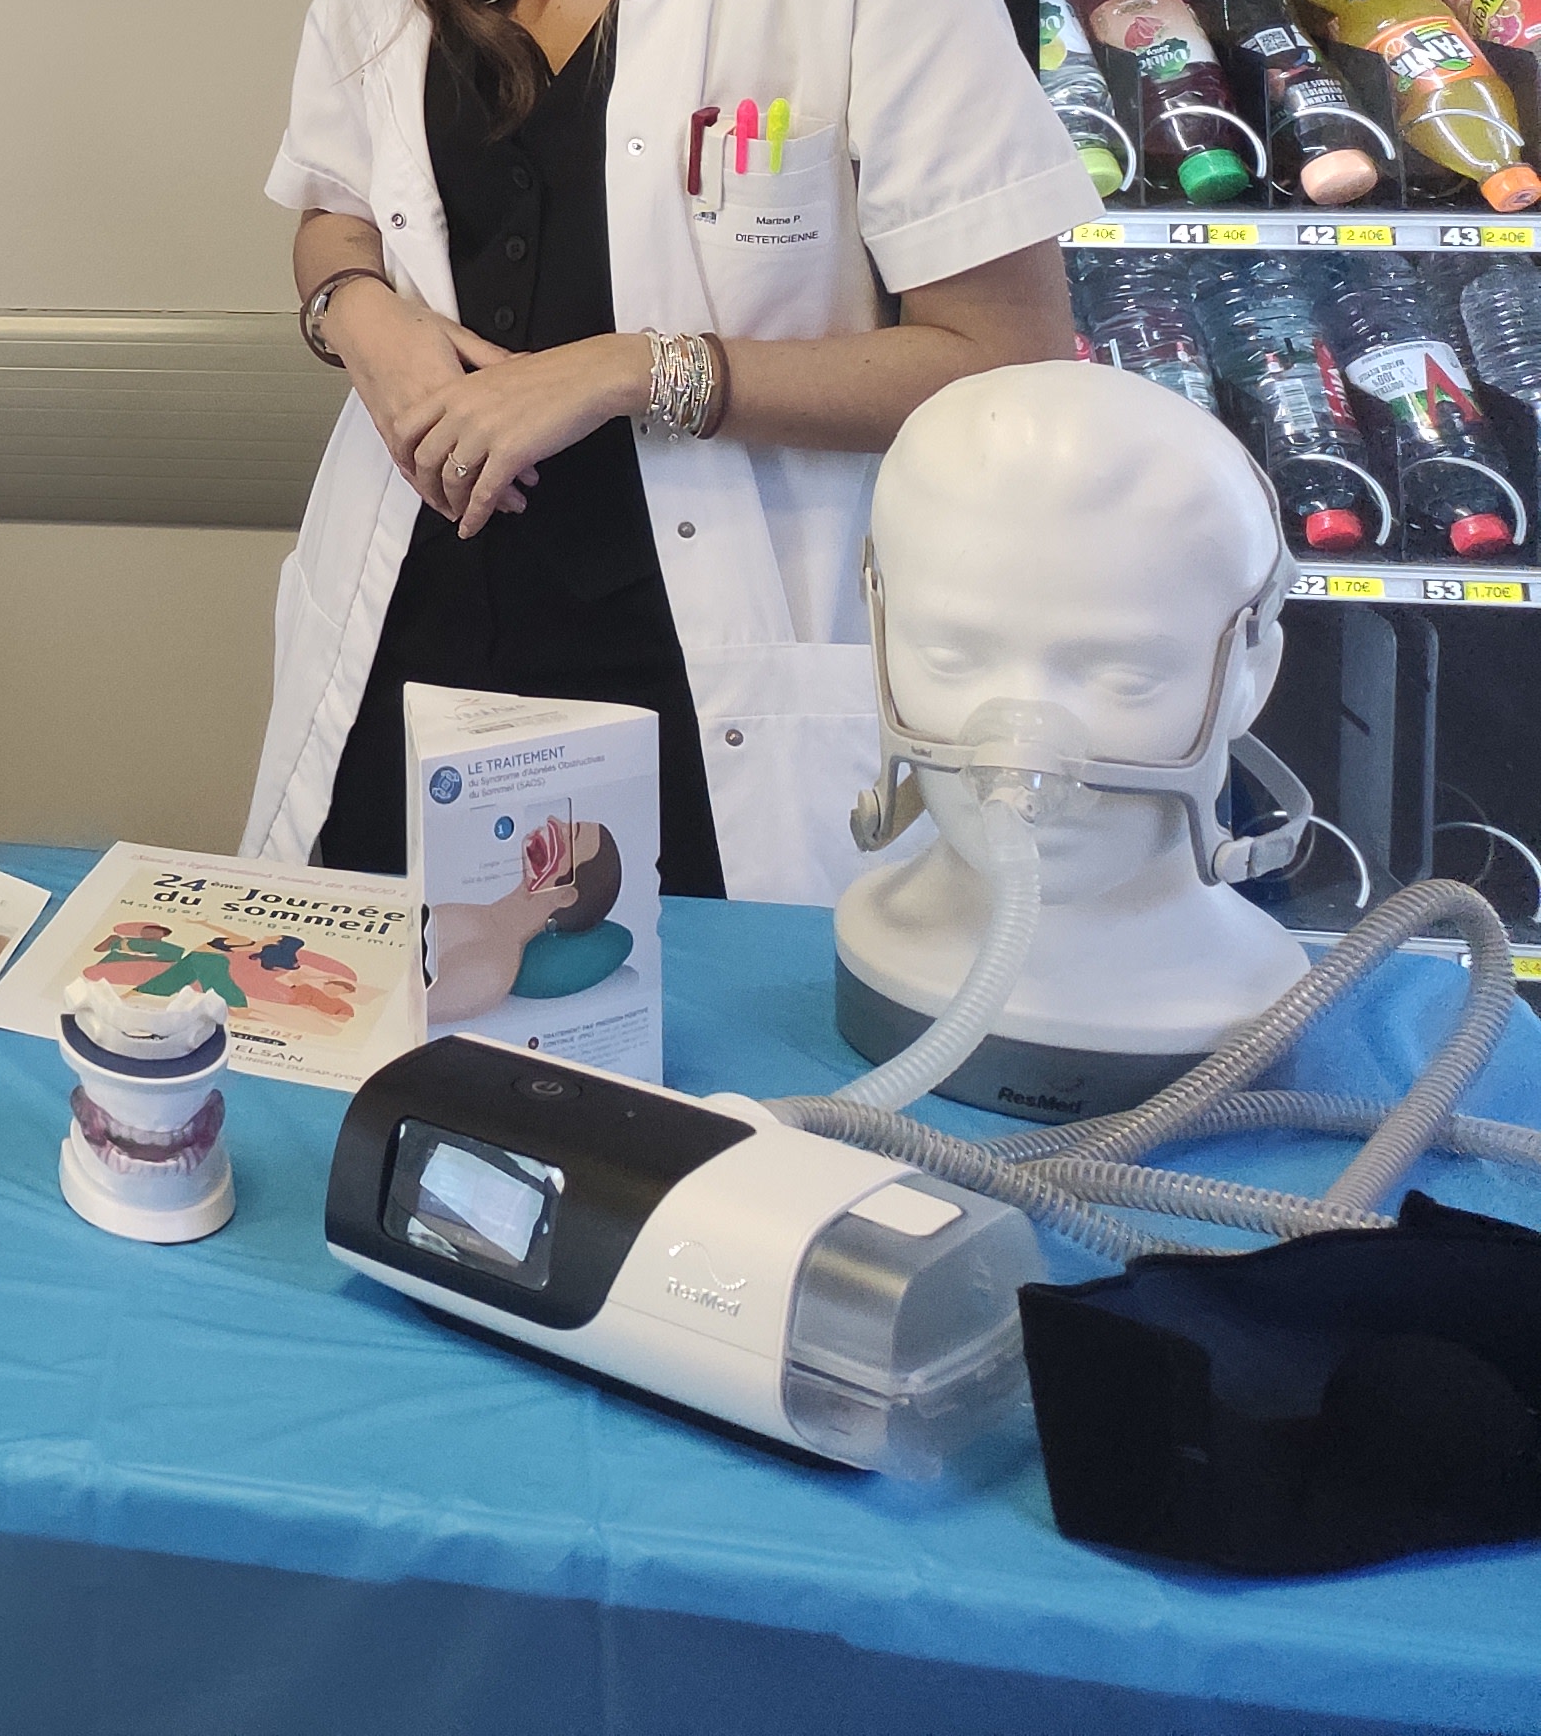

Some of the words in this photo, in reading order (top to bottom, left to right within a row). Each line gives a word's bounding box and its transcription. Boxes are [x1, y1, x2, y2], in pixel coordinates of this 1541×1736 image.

[736, 230, 819, 244] DIETETICIENNE
[1171, 224, 1204, 243] 41
[1299, 226, 1336, 244] 42
[1443, 227, 1480, 246] 43
[1427, 581, 1462, 599] 53
[468, 762, 484, 775] LE
[486, 746, 565, 772] TRAITEMENT
[154, 890, 201, 906] du
[221, 902, 390, 935] sommeil
[238, 889, 406, 922] Journée
[235, 1045, 303, 1062] ELSAN
[998, 1086, 1081, 1114] ResMed
[666, 1276, 741, 1317] ResMed
